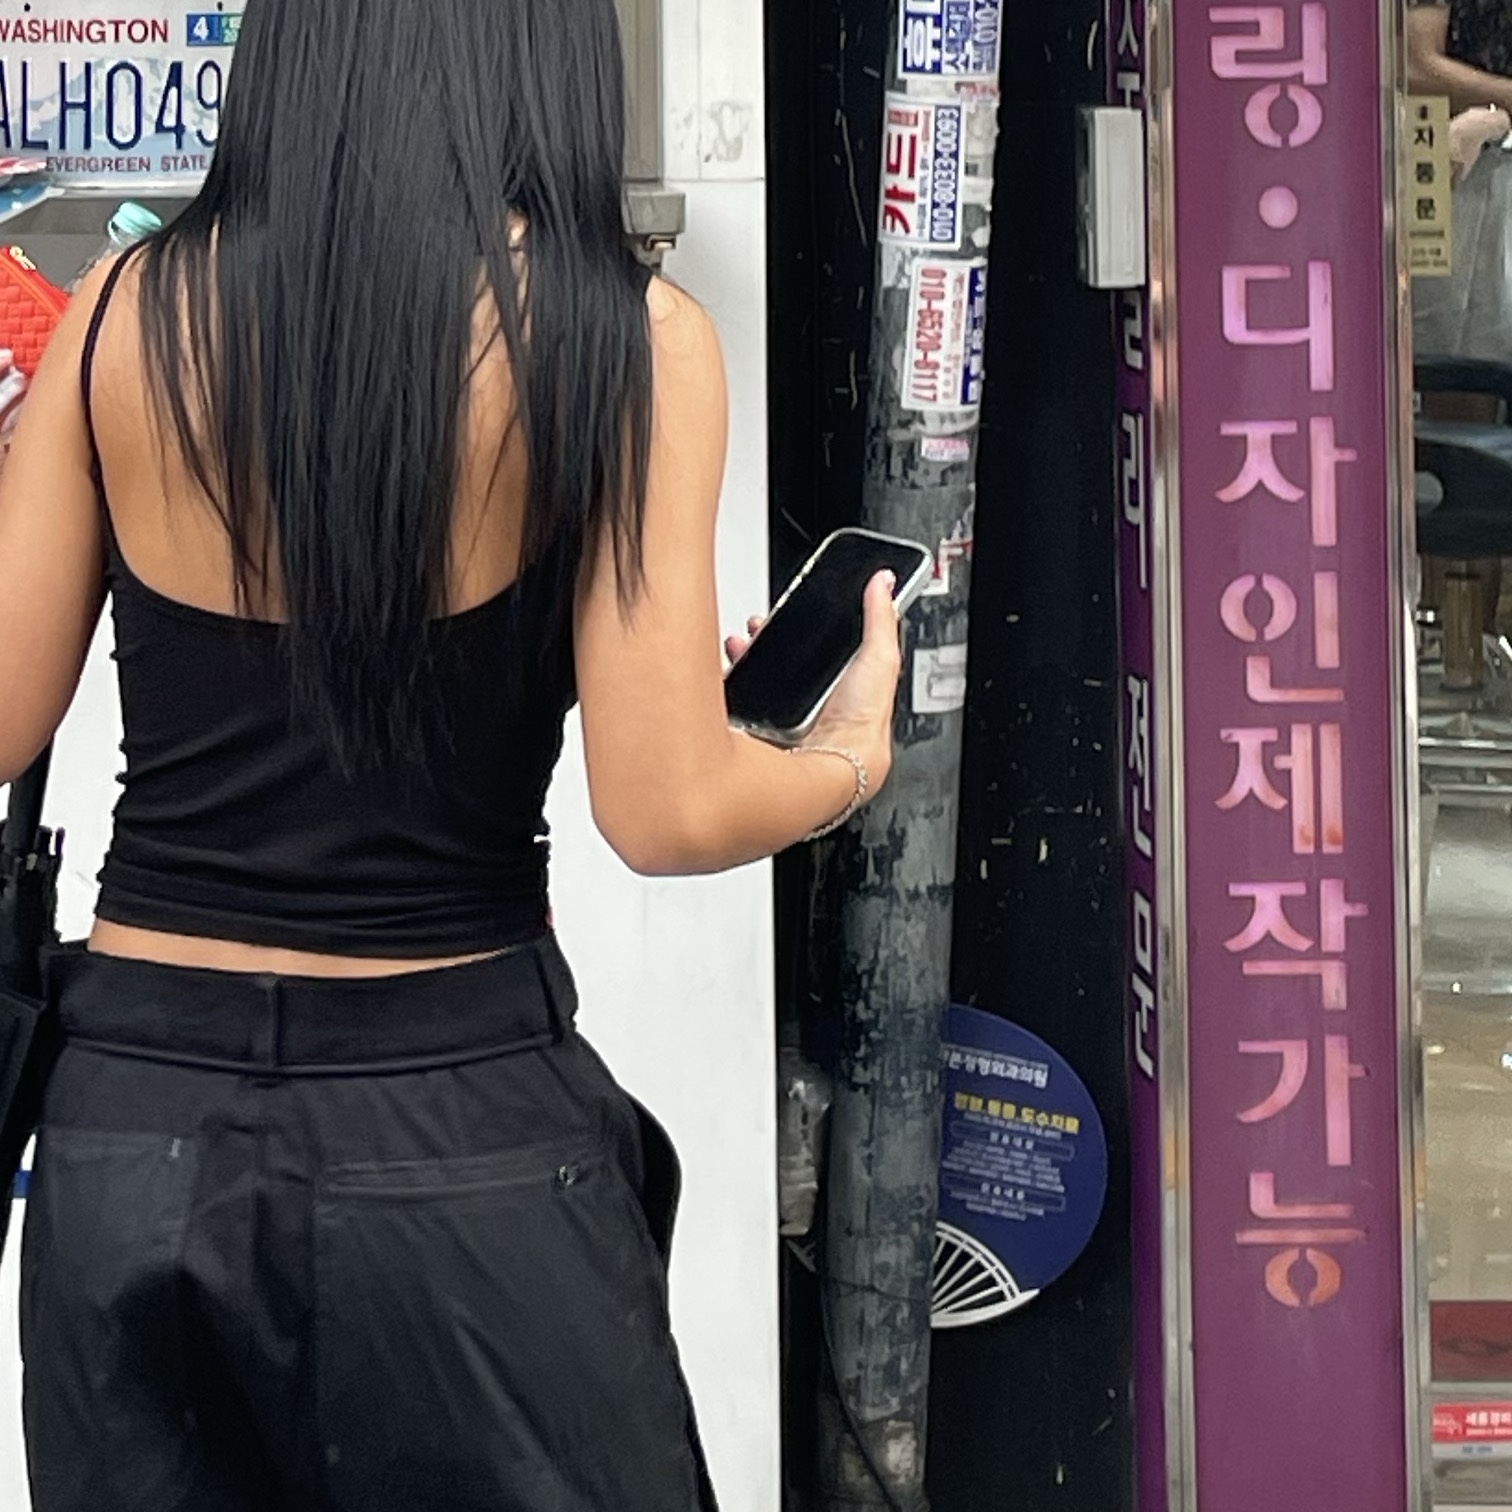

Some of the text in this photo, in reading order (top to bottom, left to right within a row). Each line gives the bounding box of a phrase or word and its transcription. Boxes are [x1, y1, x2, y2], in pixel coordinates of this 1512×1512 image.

[193, 16, 209, 40] 4
[44, 155, 208, 173] EVERGREEN STATE
[881, 133, 919, 236] 카드
